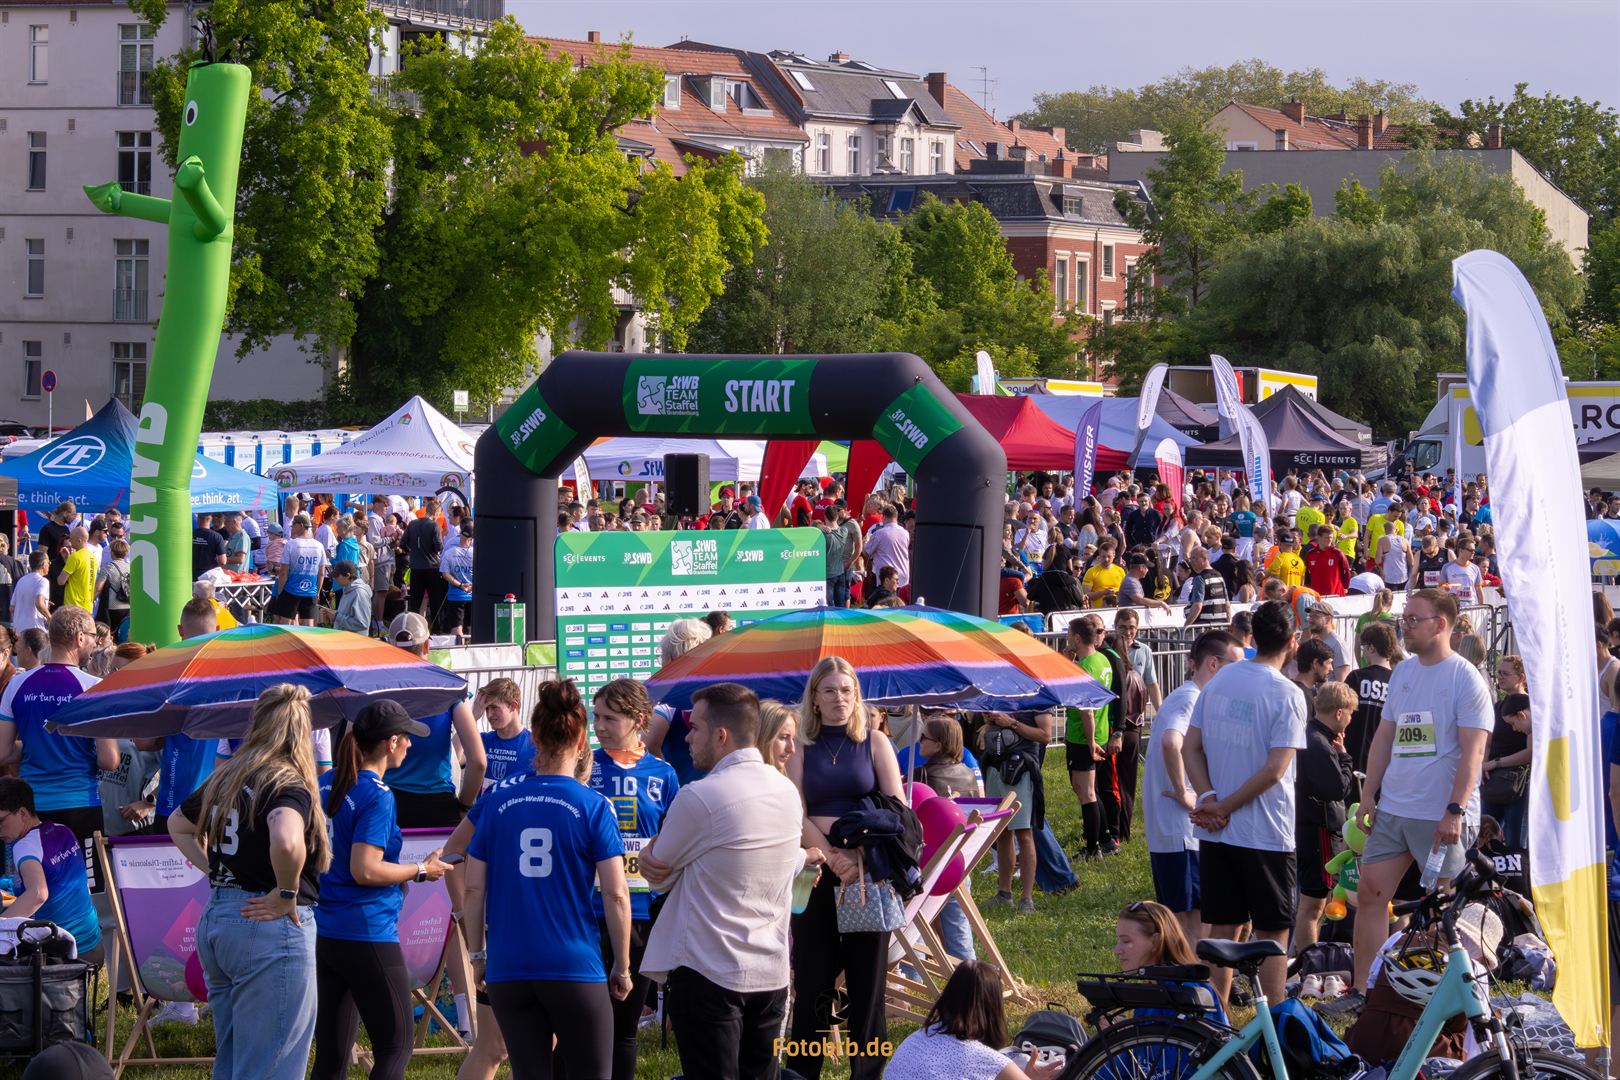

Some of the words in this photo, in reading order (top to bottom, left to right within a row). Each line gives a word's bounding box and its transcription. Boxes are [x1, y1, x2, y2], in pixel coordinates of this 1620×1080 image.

[666, 375, 700, 390] StWB
[666, 390, 698, 400] TEAM
[725, 379, 795, 413] START
[665, 400, 699, 411] Staffel
[520, 408, 546, 442] StWB
[895, 418, 929, 449] StWB
[1294, 453, 1312, 465] SCC
[1319, 456, 1357, 464] EVENTS
[638, 461, 665, 476] StW
[202, 492, 226, 505] think.
[227, 491, 243, 504] act.
[693, 539, 718, 552] StWB
[297, 556, 318, 565] ONE
[630, 552, 652, 565] StWB
[692, 552, 718, 561] TEAM
[742, 549, 764, 562] StWB
[796, 550, 820, 558] EVENTS
[693, 561, 718, 570] Staffel
[24, 694, 38, 702] Wir
[39, 692, 55, 702] tun
[611, 776, 638, 796] 10
[498, 803, 507, 815] SV
[519, 827, 553, 878] 8
[1494, 854, 1522, 872] BN
